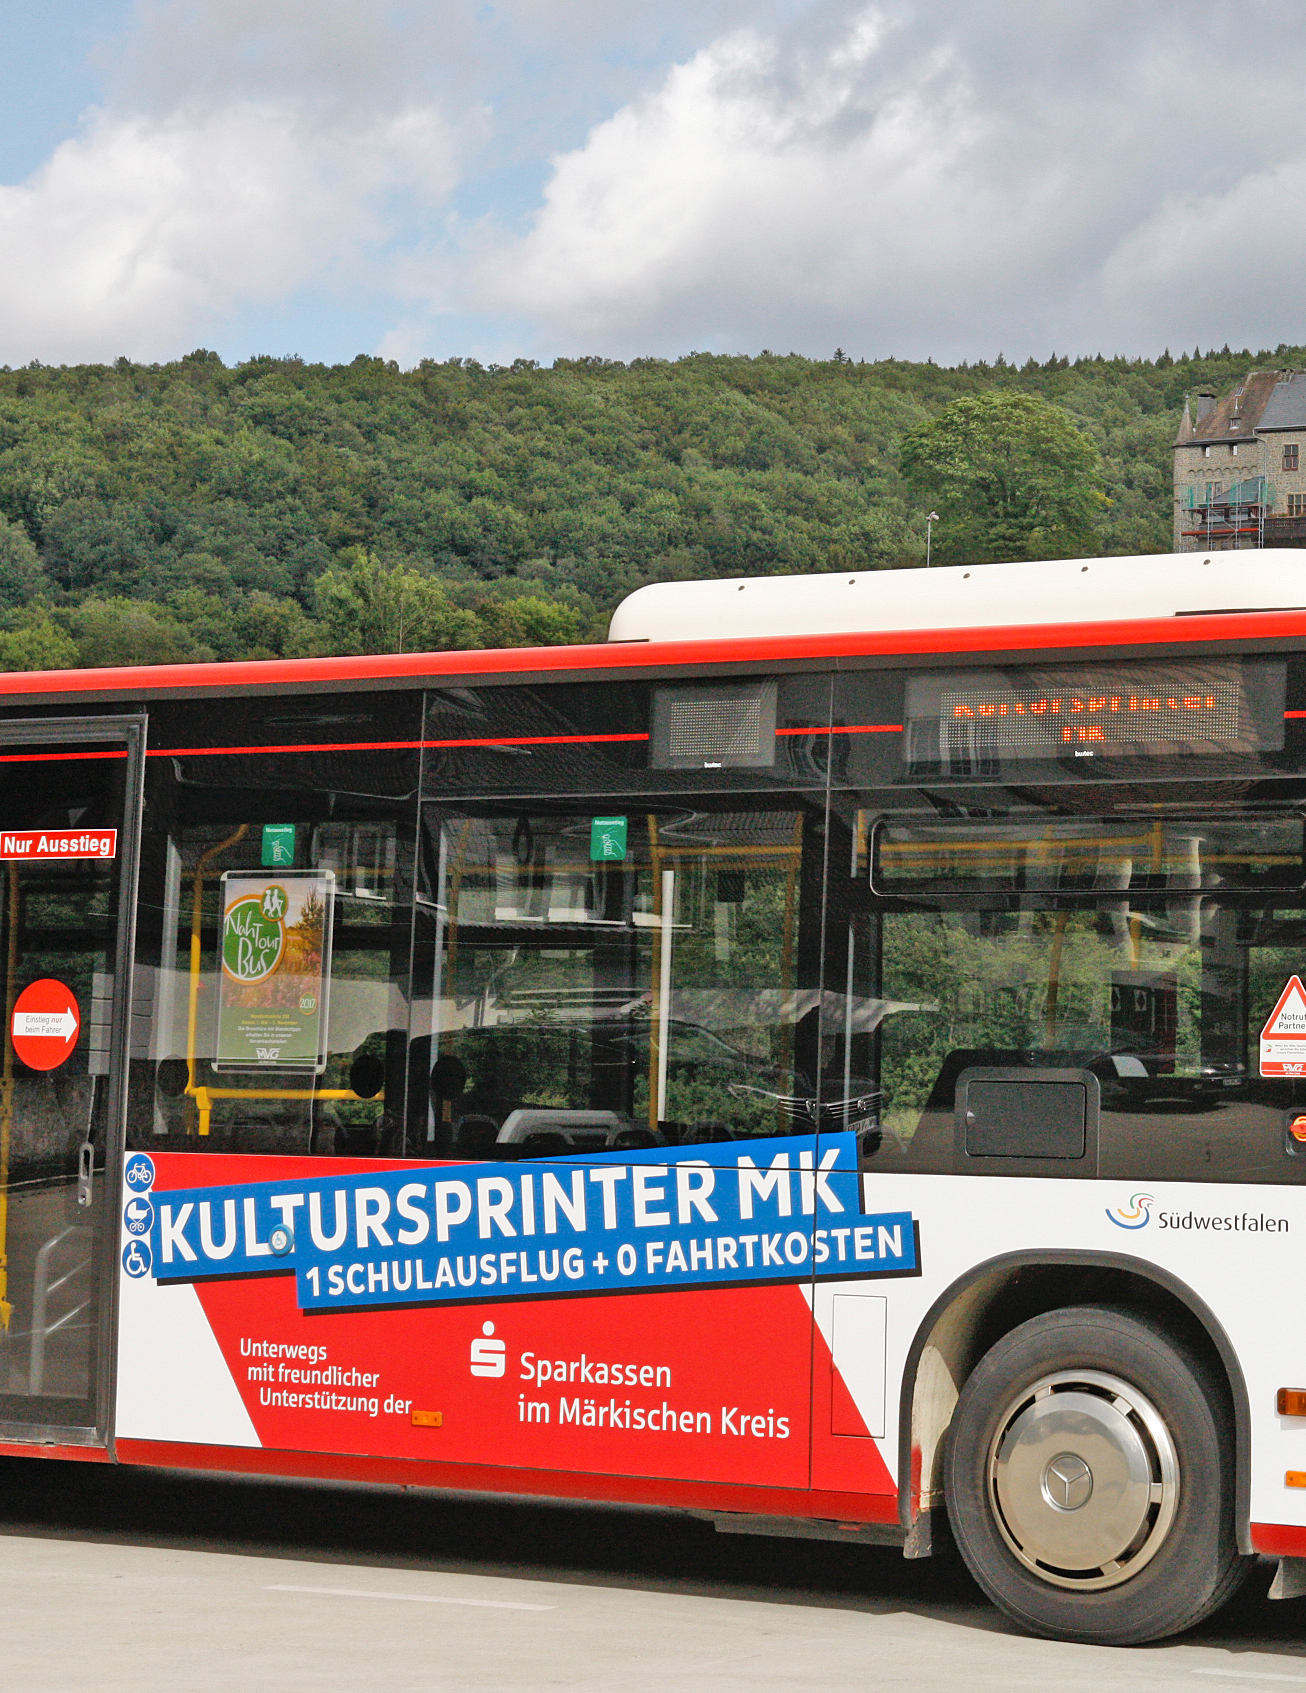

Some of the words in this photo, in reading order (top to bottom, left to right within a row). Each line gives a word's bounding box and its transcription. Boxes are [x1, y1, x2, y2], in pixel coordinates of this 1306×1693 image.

[3, 836, 33, 853] Nur
[36, 834, 111, 856] Ausstieg
[237, 936, 270, 978] Bus
[300, 998, 316, 1009] 2017
[25, 1015, 50, 1025] Einstieg
[25, 1025, 40, 1033] beim
[41, 1026, 62, 1034] Fahrer
[255, 1047, 281, 1059] MVG
[1282, 1063, 1305, 1071] MVG
[160, 1160, 719, 1263] KULTURSPRINTER
[737, 1148, 845, 1220] MK
[1158, 1211, 1289, 1233] Südwestfalen
[305, 1266, 320, 1297] 1
[328, 1247, 585, 1296] SCHULAUSFLUG
[592, 1251, 609, 1275] +
[617, 1244, 637, 1276] 0
[646, 1224, 903, 1274] FAHRTKOSTEN
[239, 1337, 327, 1361] Unterwegs
[247, 1363, 274, 1382] mit
[277, 1364, 380, 1388] freundlicher
[519, 1351, 672, 1389] Sparkassen
[259, 1387, 379, 1417] Unterstützung
[383, 1393, 412, 1415] der
[518, 1394, 551, 1424] im
[558, 1397, 712, 1434] Märkischen
[721, 1406, 790, 1439] Kreis
